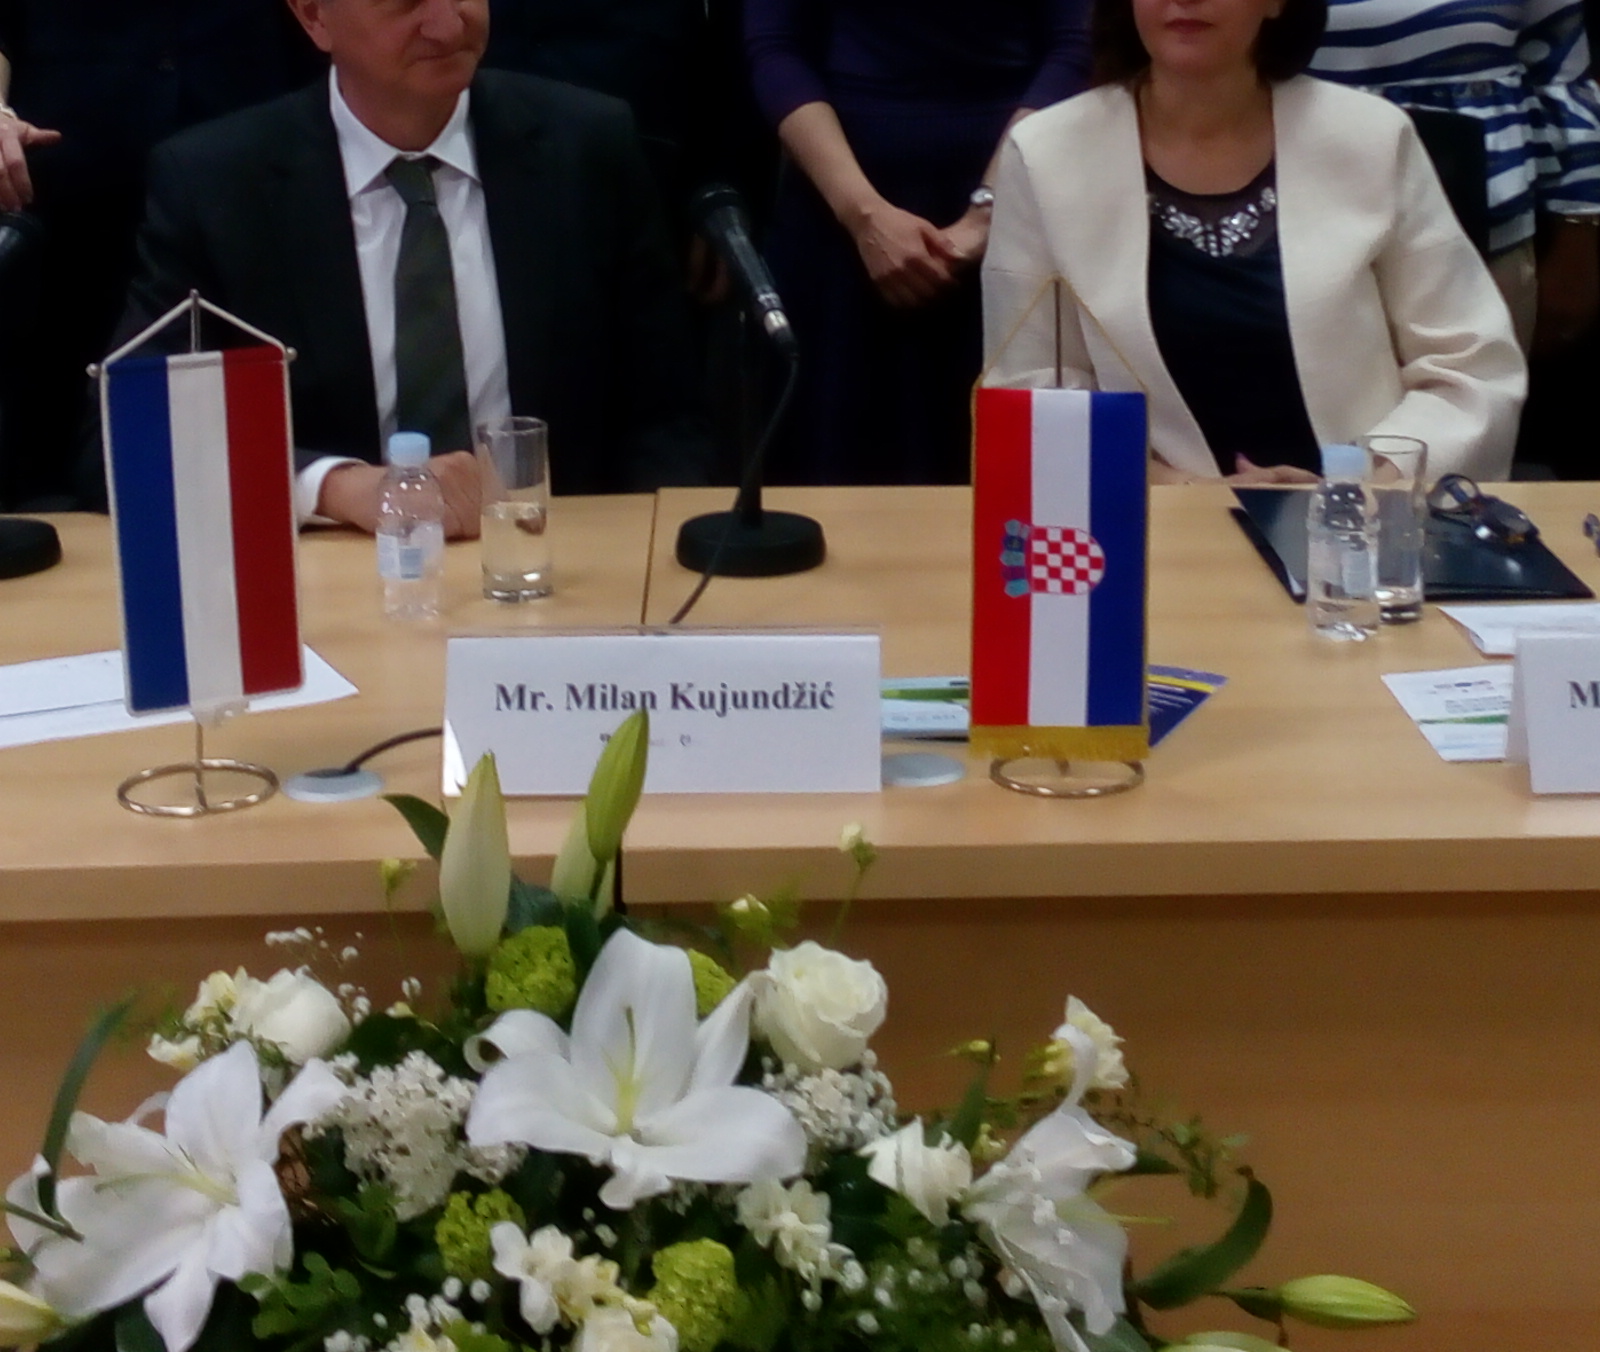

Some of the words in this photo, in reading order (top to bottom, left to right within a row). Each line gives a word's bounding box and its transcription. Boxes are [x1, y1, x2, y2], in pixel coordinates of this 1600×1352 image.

[495, 683, 554, 711] Mr.
[565, 682, 657, 711] Milan
[669, 681, 834, 717] Kujundžić
